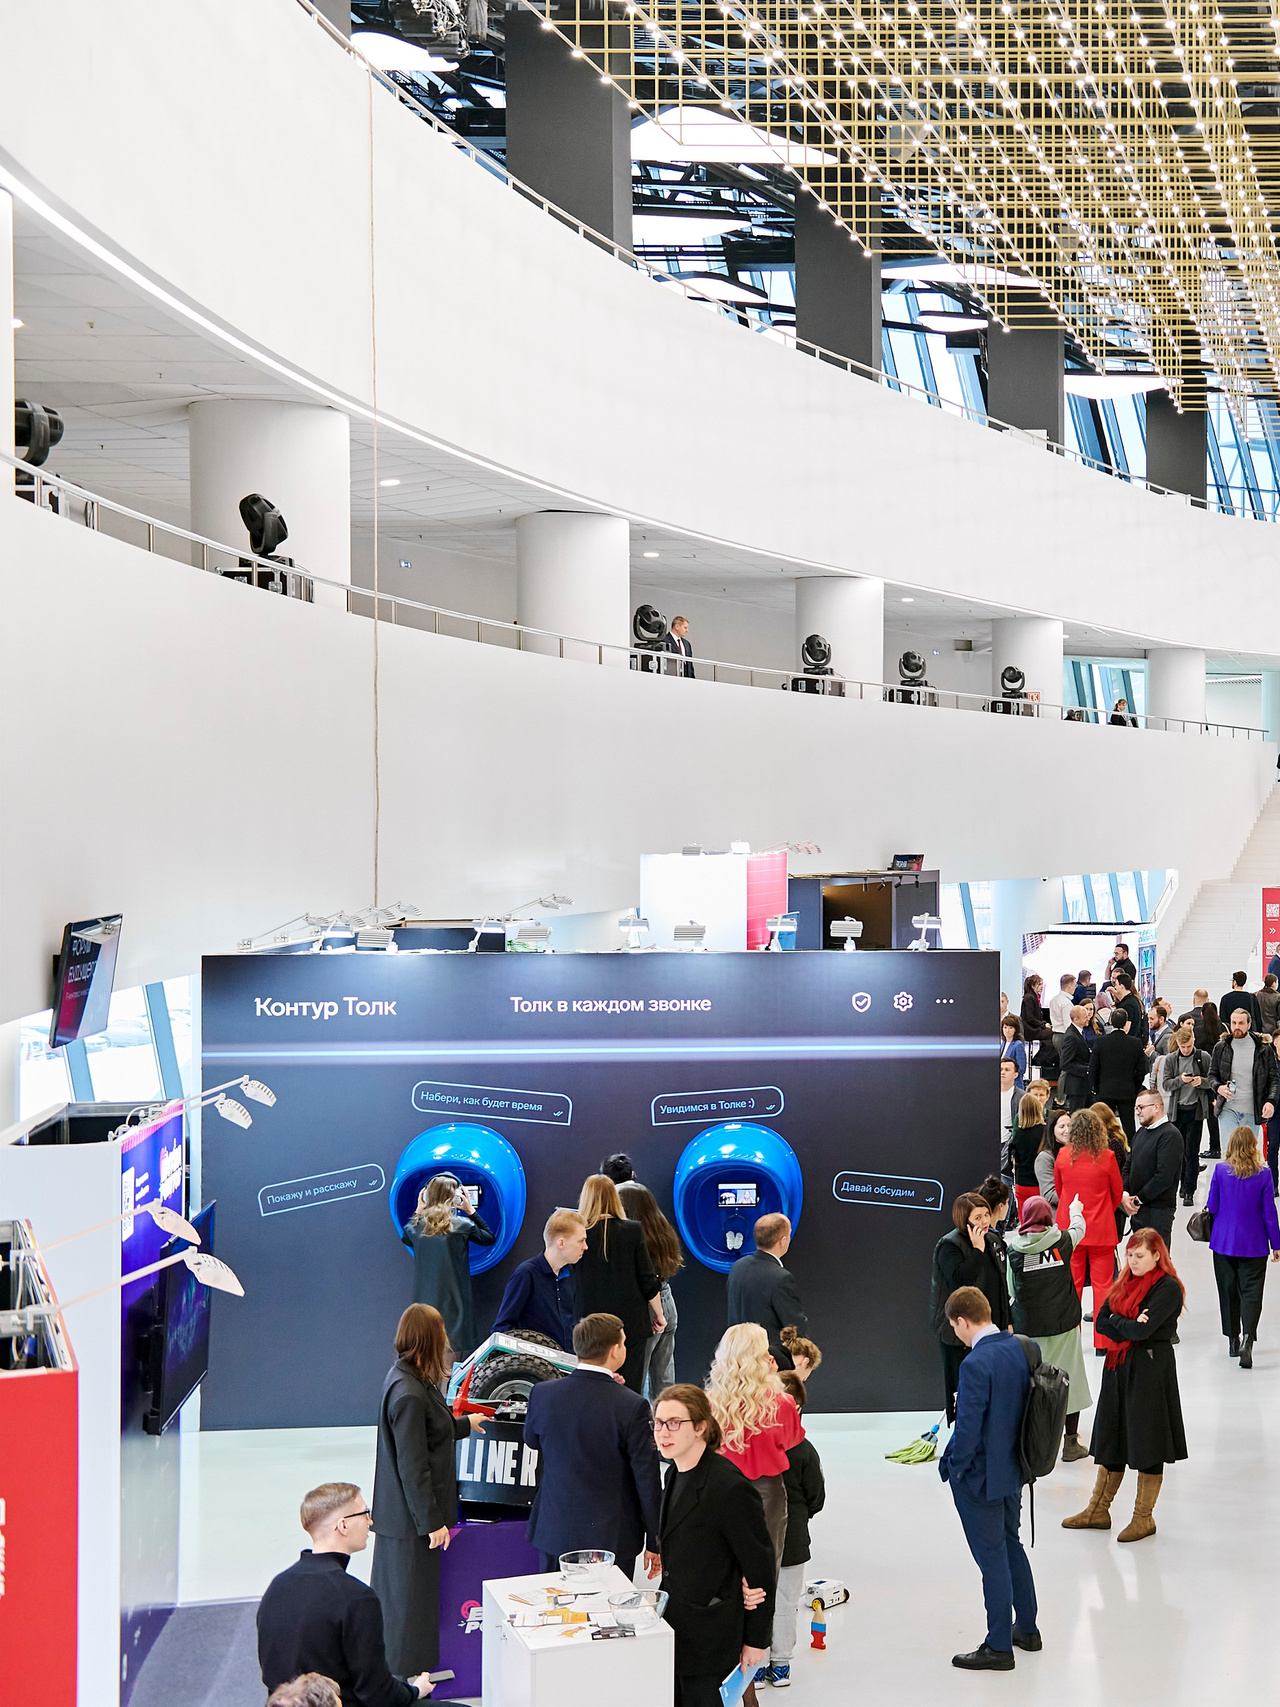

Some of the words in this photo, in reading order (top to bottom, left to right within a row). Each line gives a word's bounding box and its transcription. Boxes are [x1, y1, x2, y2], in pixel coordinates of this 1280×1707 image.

[254, 997, 339, 1020] Контур
[343, 997, 397, 1016] Толк
[510, 996, 553, 1013] Толк
[557, 1000, 568, 1012] в
[572, 999, 644, 1014] каждом
[648, 998, 711, 1012] звонке
[420, 1091, 461, 1105] Набери,
[463, 1098, 480, 1106] как
[482, 1097, 509, 1109] будет
[511, 1101, 543, 1111] время
[660, 1103, 709, 1114] Увидимся
[718, 1100, 747, 1110] Толке
[267, 1190, 304, 1205] Покажу
[313, 1179, 358, 1196] расскажу
[841, 1182, 872, 1193] Давай
[873, 1185, 915, 1197] обсудим
[458, 1438, 539, 1487] LINER
